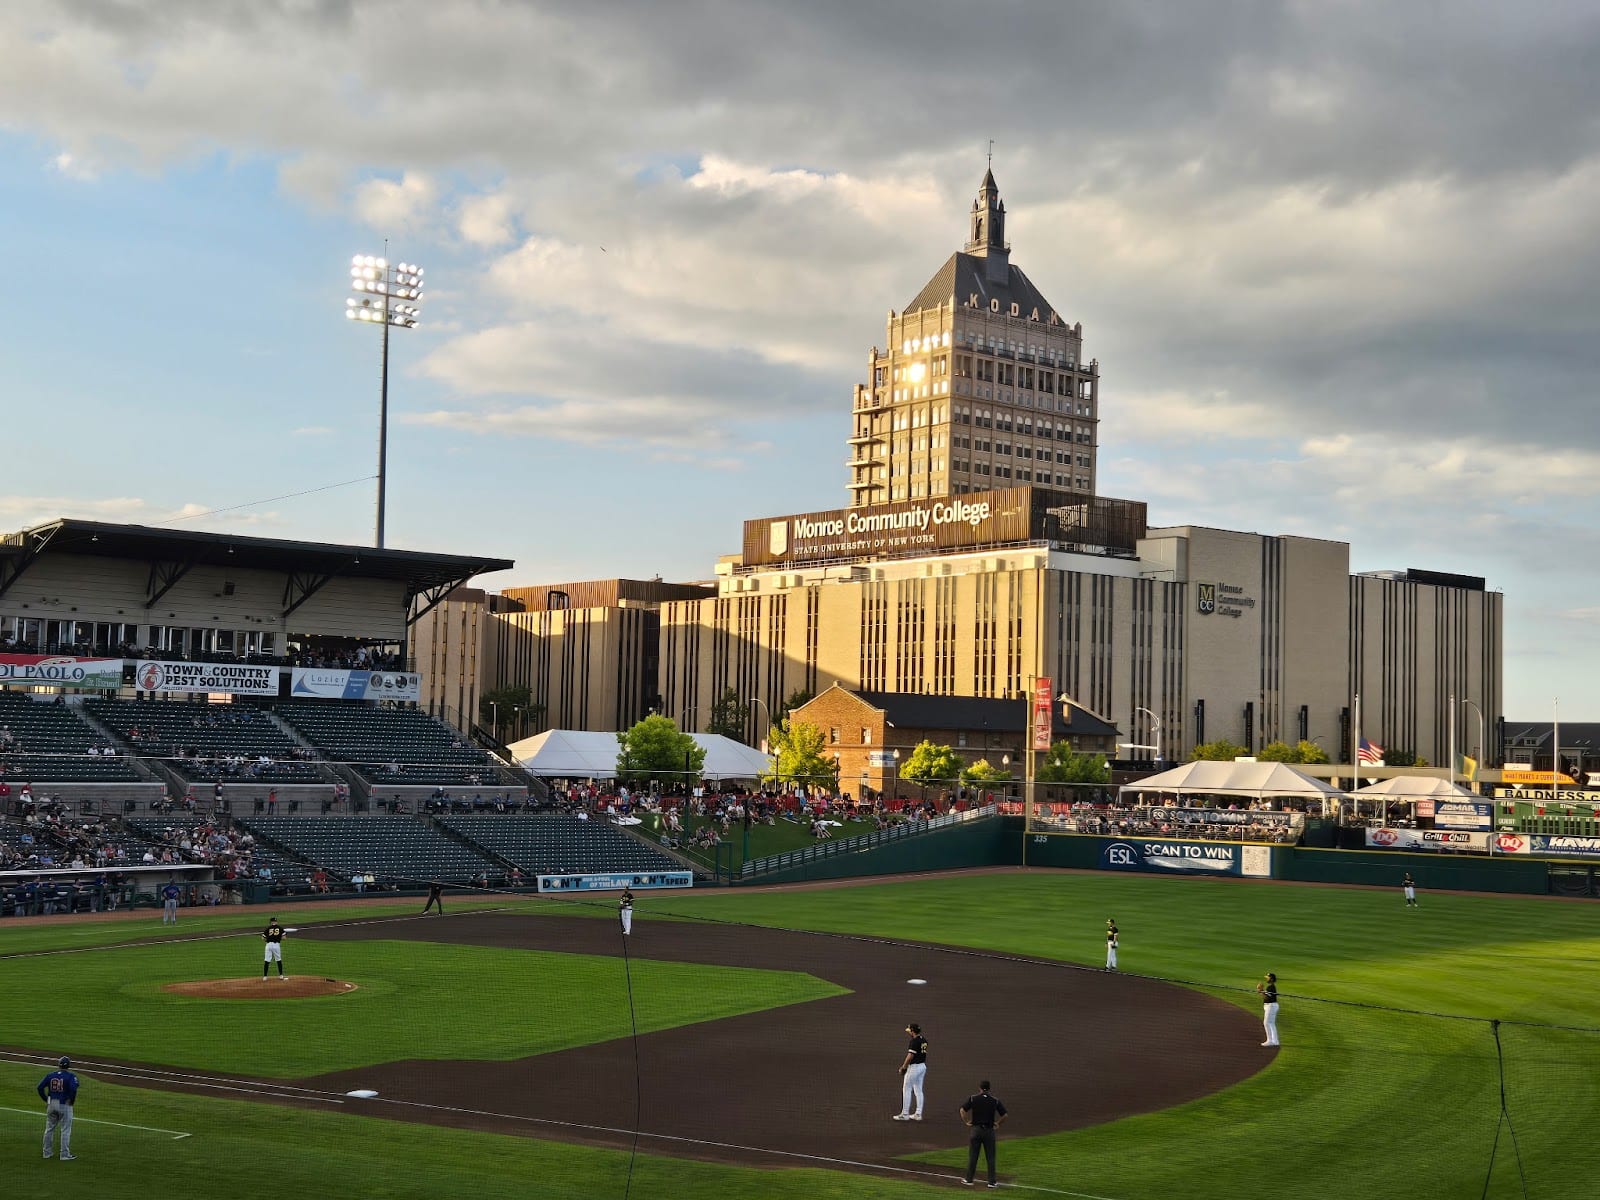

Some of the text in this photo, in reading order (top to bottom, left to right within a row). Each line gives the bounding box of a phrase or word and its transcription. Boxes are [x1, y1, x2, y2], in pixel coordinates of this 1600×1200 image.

[969, 293, 1058, 325] KODAK
[794, 501, 991, 540] Monroe Community College
[794, 534, 935, 555] STATE UNIVERSITY OF NEW YORK
[1218, 582, 1243, 593] Monroe
[1218, 605, 1242, 618] College
[25, 664, 85, 680] PAOLO
[165, 675, 269, 689] PEST SOLUTIONS
[1376, 832, 1395, 842] DQ
[1500, 837, 1520, 849] DQ
[1109, 844, 1233, 865] ESL SCAN TO WIN
[666, 877, 689, 886] SPEED
